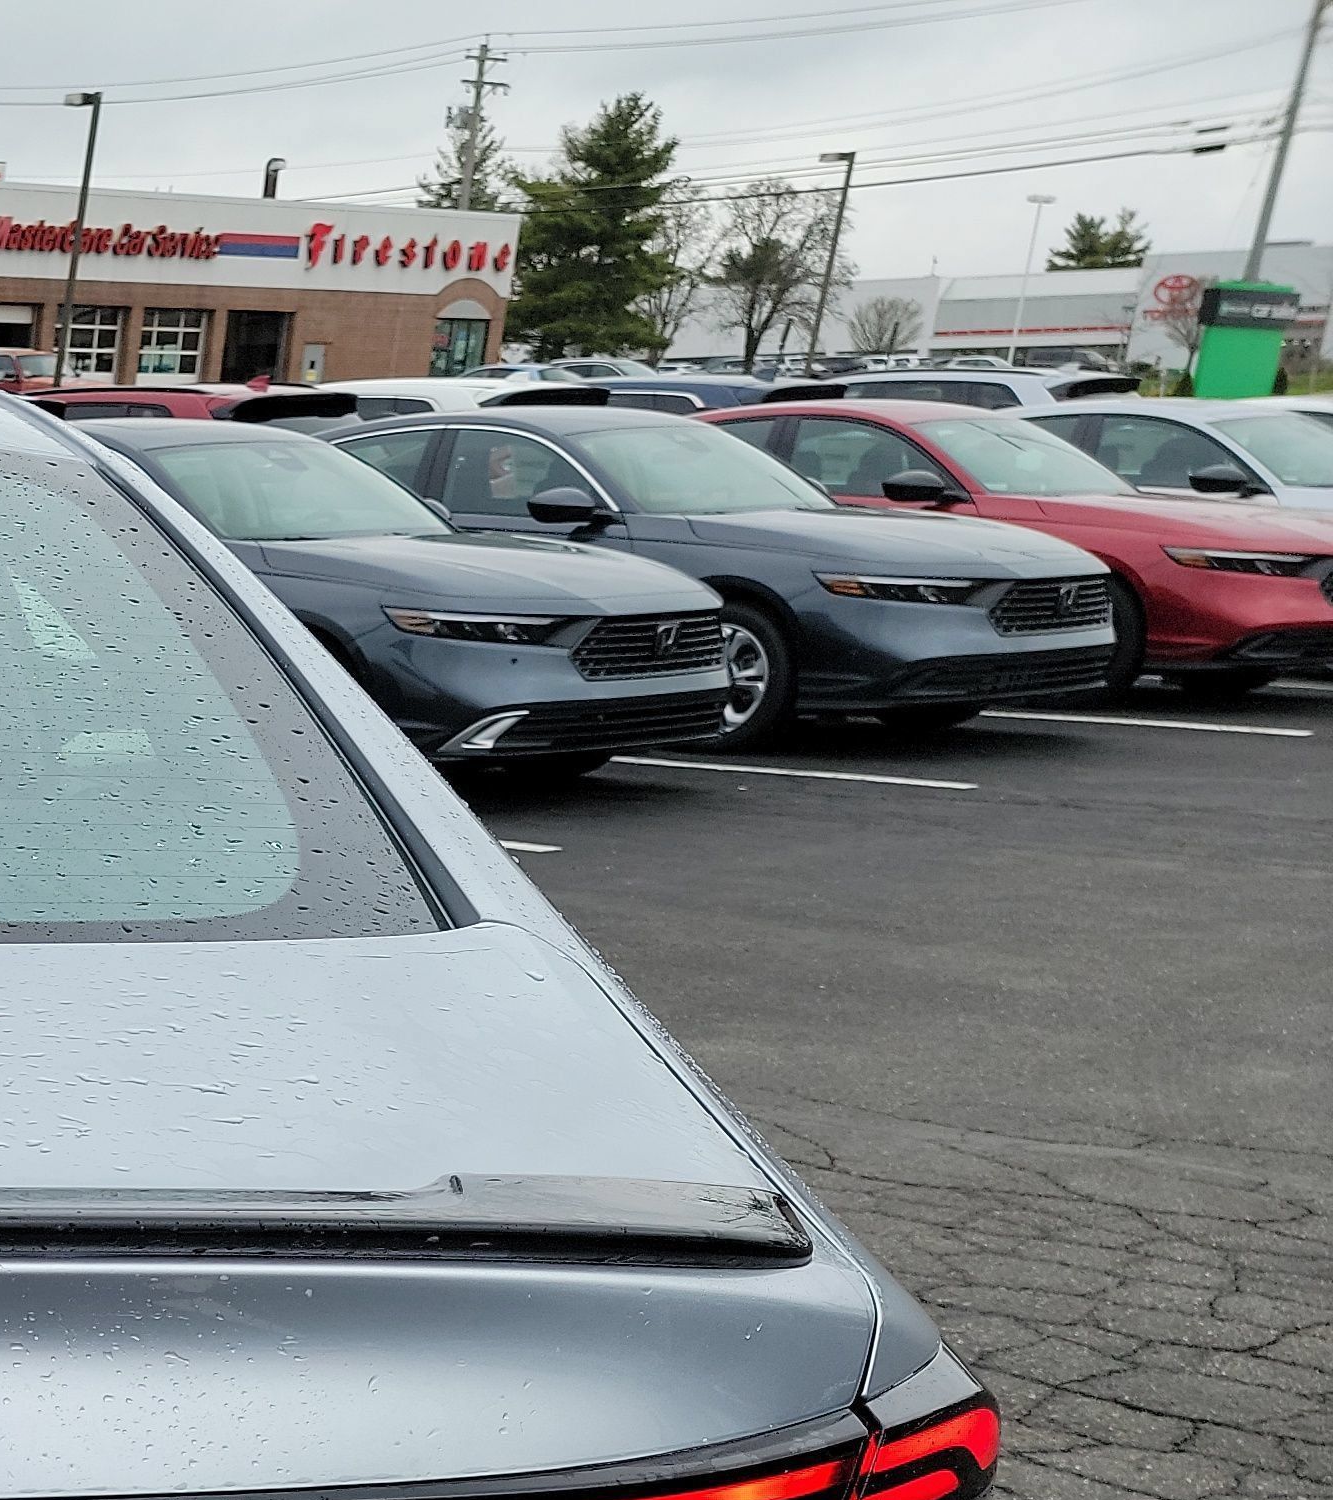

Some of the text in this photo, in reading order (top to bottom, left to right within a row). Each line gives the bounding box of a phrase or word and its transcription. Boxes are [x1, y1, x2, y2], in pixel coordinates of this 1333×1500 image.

[113, 223, 152, 255] Car
[148, 225, 221, 260] Service
[305, 223, 511, 271] Firestone
